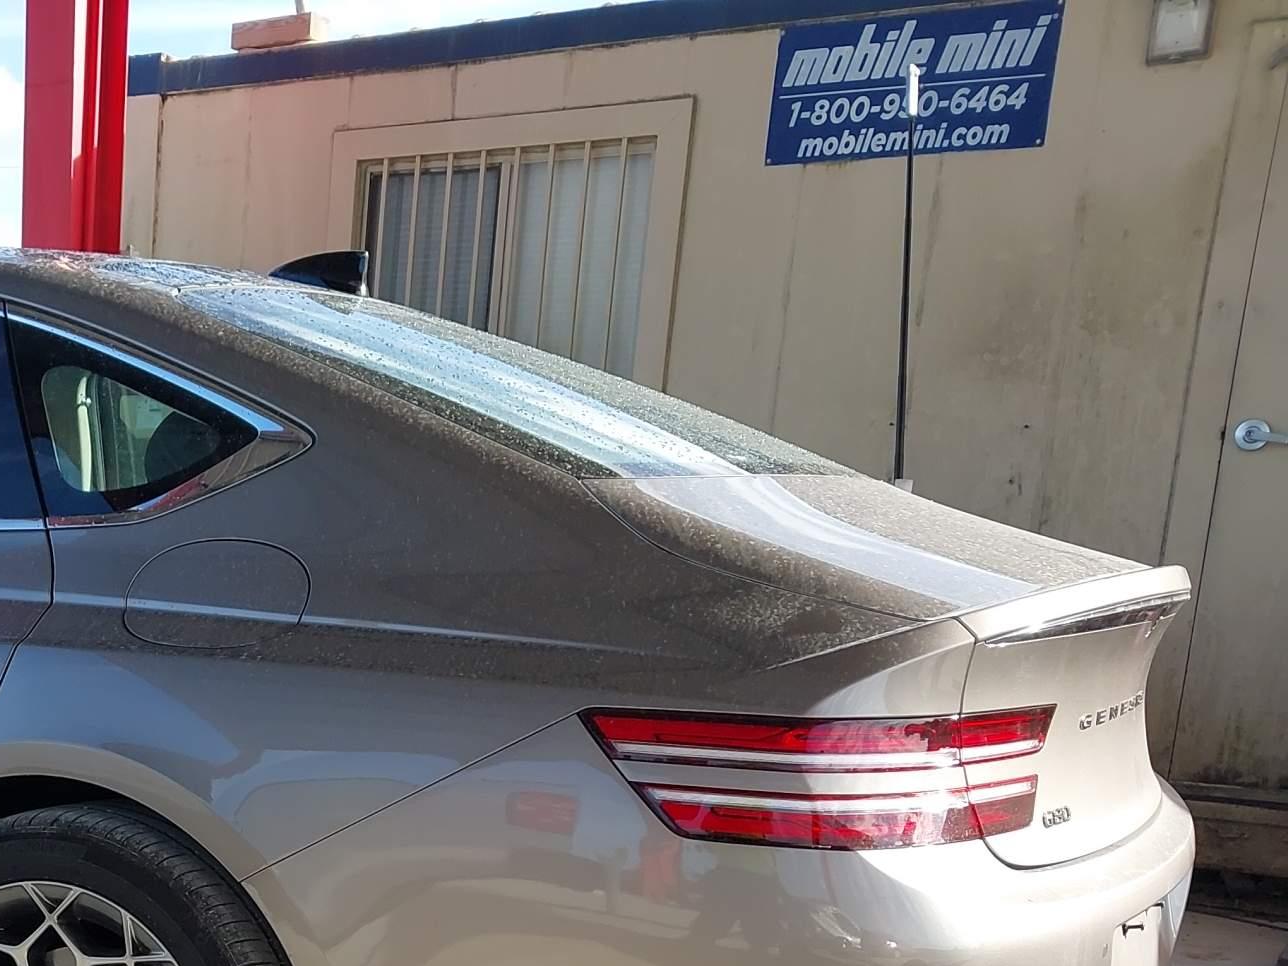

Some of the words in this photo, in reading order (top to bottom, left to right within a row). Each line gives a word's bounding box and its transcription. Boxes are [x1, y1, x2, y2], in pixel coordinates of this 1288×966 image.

[782, 20, 935, 88] mobile
[935, 14, 1051, 74] mini
[797, 122, 1010, 158] mobilemini.com
